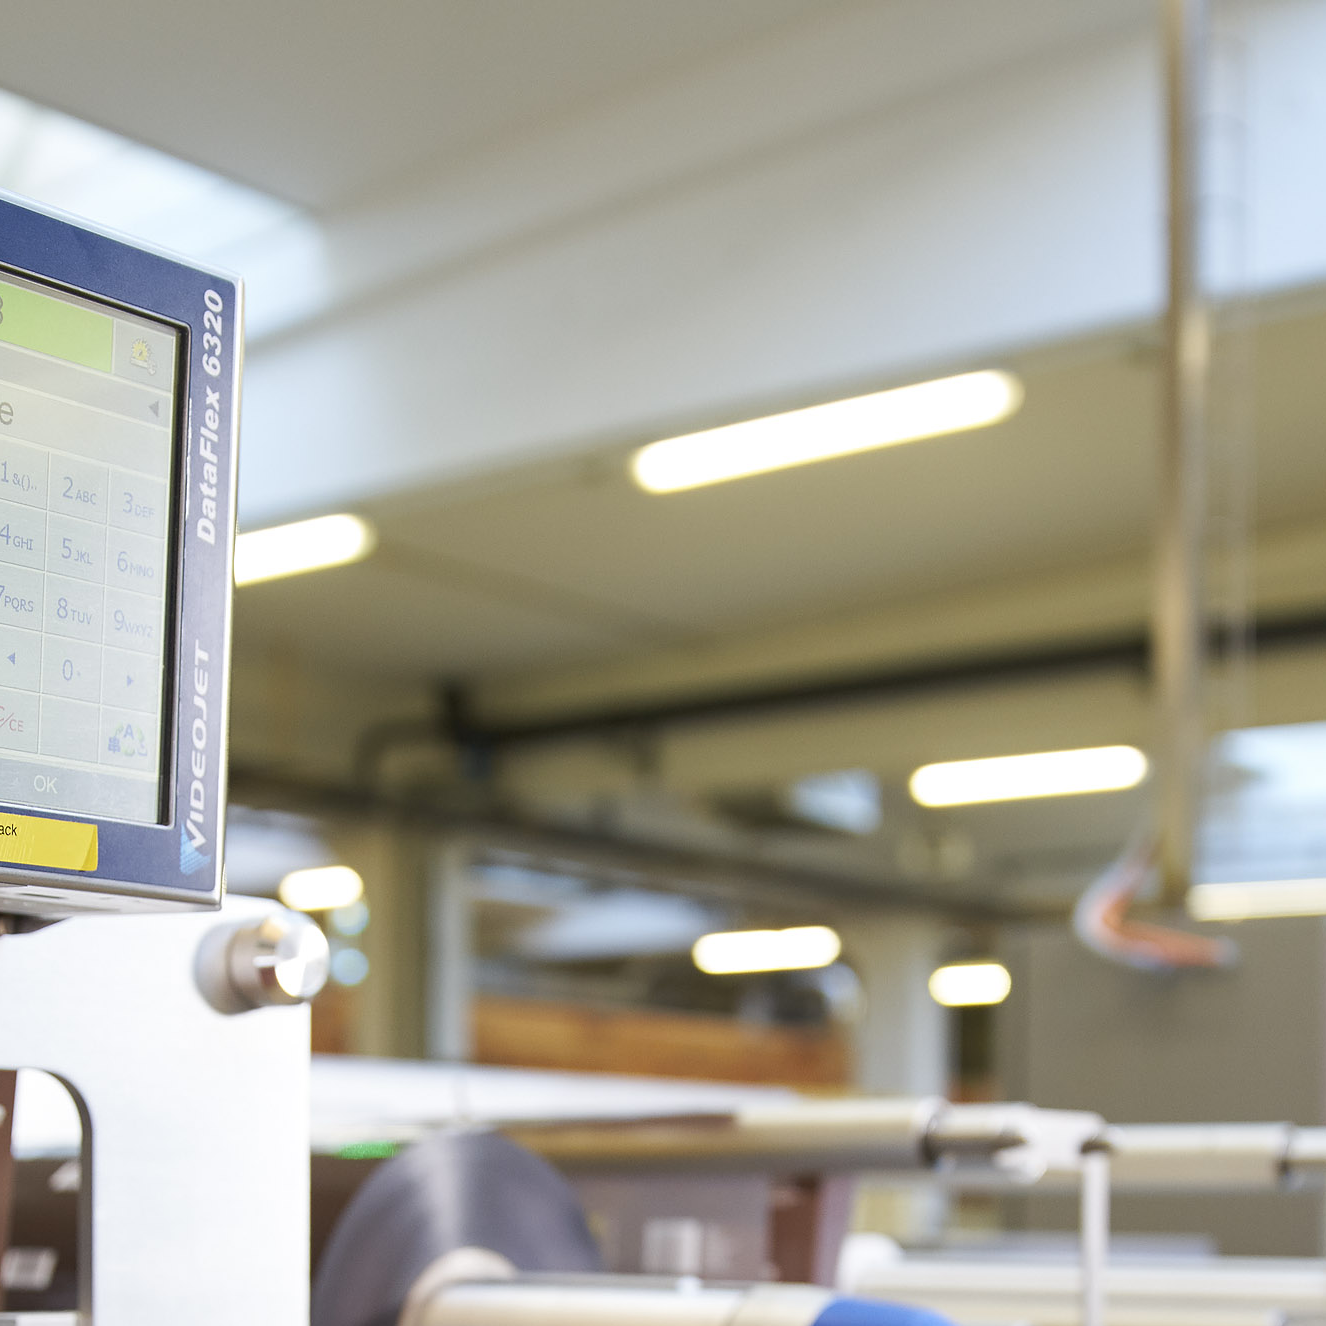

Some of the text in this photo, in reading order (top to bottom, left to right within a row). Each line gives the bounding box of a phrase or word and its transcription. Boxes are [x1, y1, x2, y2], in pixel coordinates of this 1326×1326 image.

[196, 288, 224, 546] DataFlex 6320
[33, 774, 59, 795] OK
[185, 639, 210, 850] VIDEOJET
